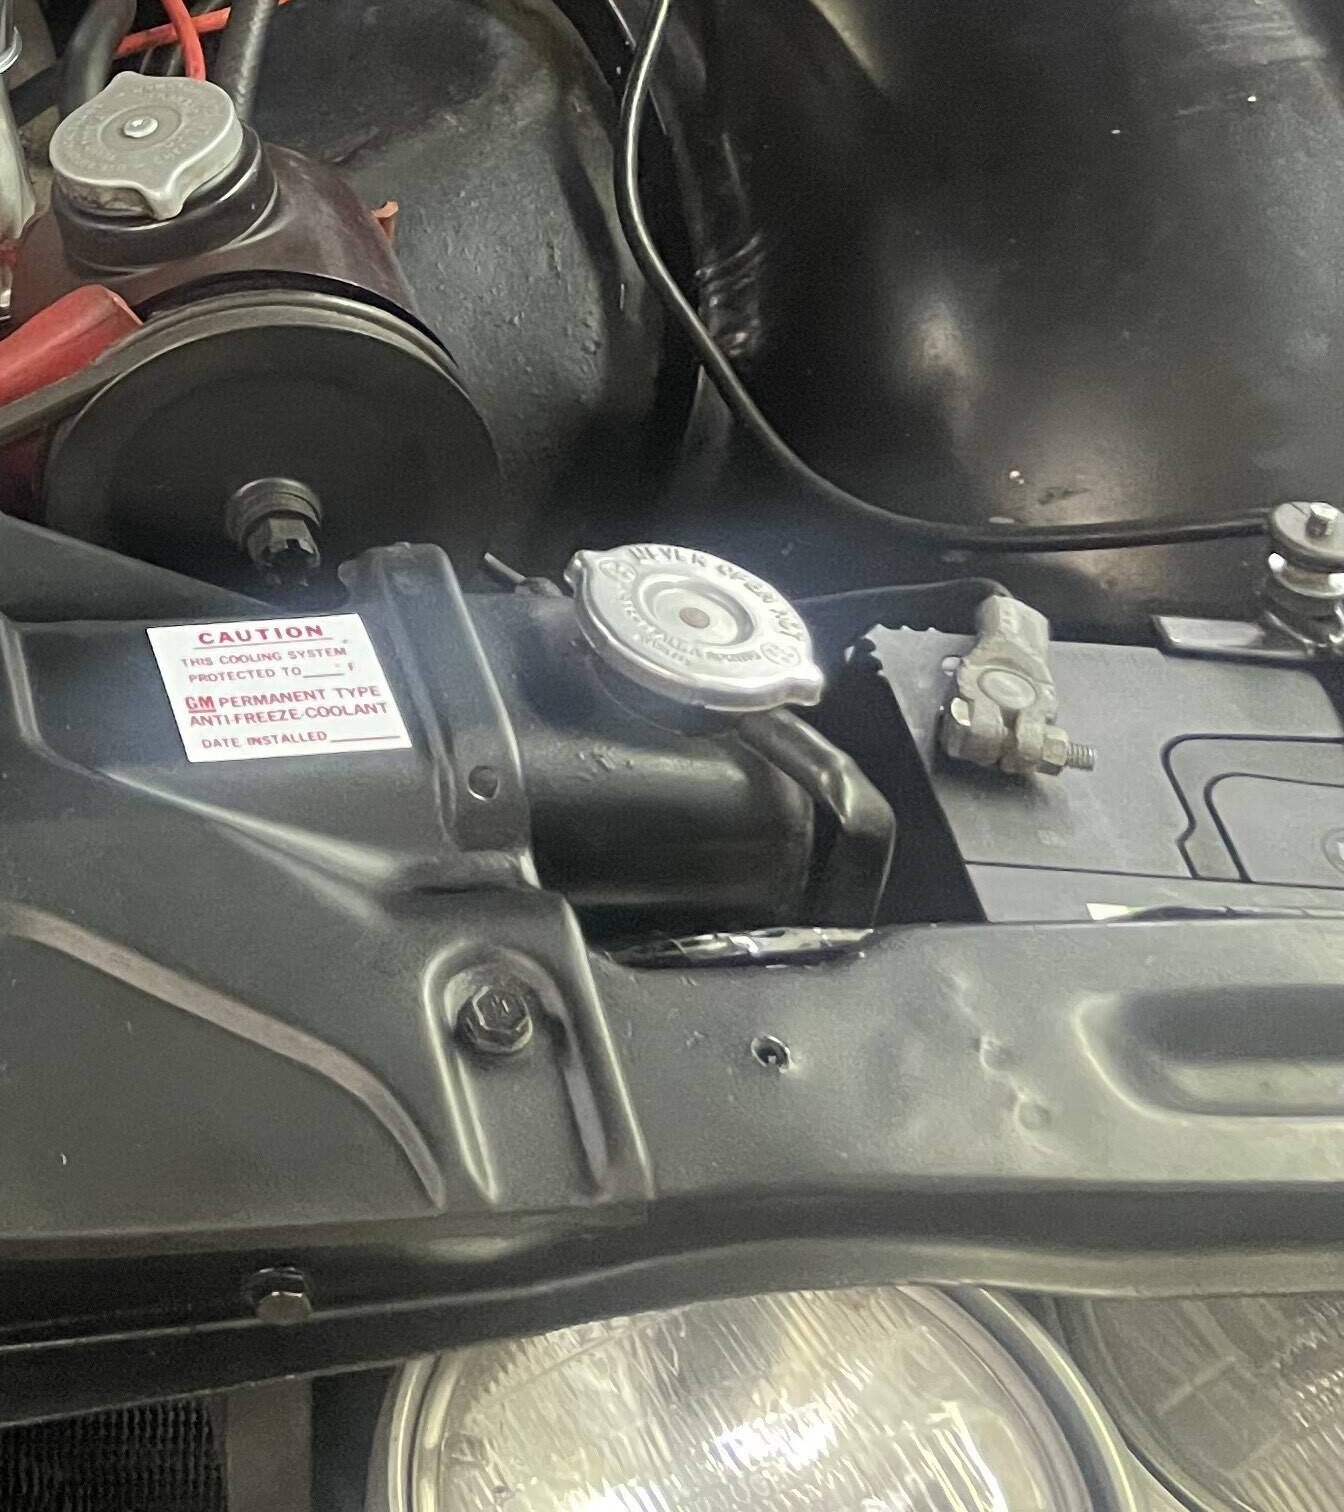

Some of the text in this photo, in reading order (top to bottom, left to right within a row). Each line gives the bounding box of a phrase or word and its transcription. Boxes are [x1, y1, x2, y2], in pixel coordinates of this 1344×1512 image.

[198, 624, 324, 645] CAUTION
[181, 648, 347, 668] THIS COOLING SYSTEM
[189, 668, 276, 683] PROTECTED
[284, 666, 302, 677] TO
[185, 686, 381, 711] GM PERMANENT TYPE
[202, 731, 327, 749] DATE INSTALLED
